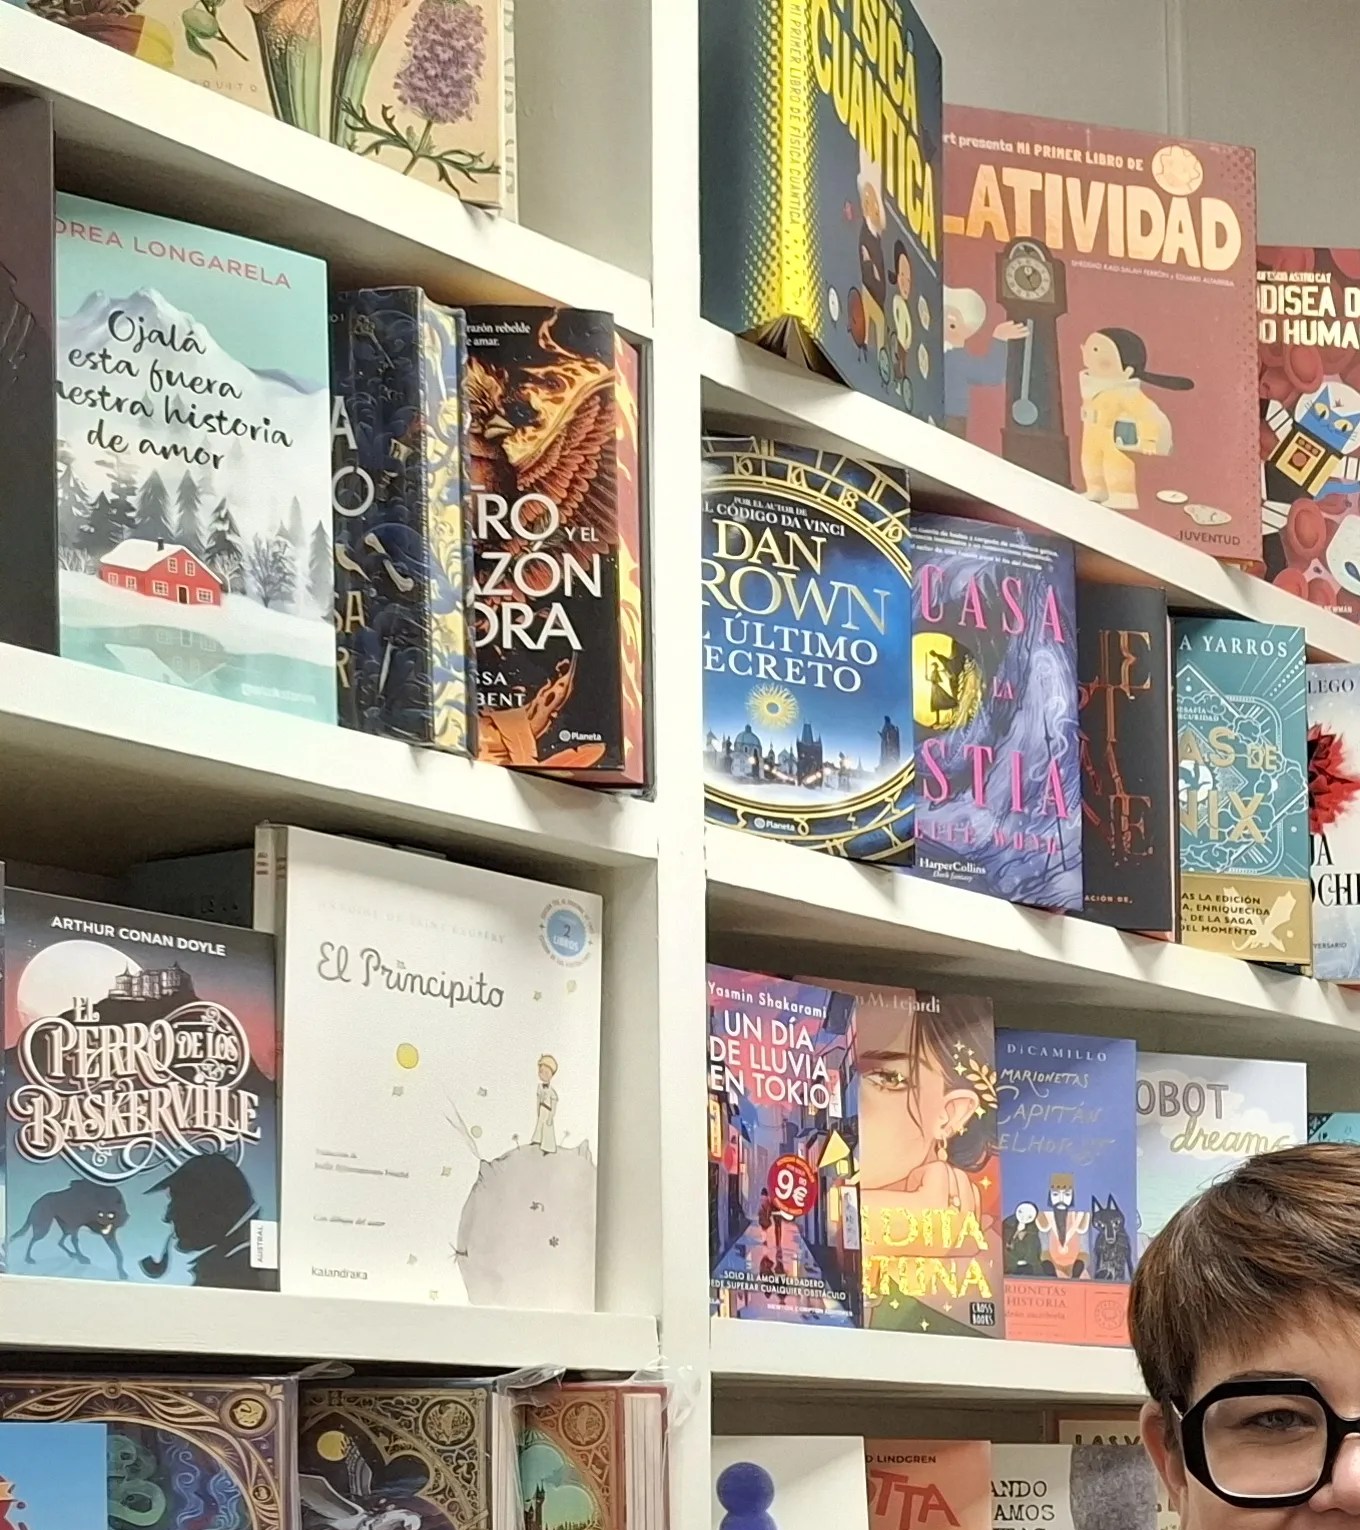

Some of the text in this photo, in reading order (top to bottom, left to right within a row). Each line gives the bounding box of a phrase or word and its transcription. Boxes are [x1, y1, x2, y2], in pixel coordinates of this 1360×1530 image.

[789, 19, 802, 103] PRIMER LIBRO
[812, 0, 937, 262] CUÁNTICA
[958, 135, 1144, 172] presenta MI PRIMER LIBRO DE
[56, 217, 292, 290] DREA LONGARELA
[1257, 284, 1337, 318] DISEA
[106, 309, 208, 356] Ojalá
[494, 321, 532, 335] rebelde
[67, 346, 244, 400] esta fuera
[164, 394, 294, 449] historia
[86, 418, 226, 471] de amor
[564, 526, 600, 543] Y EL
[716, 500, 846, 537] CÓDIGO DA VINCI
[1177, 527, 1242, 548] JUVENTUD
[712, 517, 828, 577] DAN
[701, 557, 892, 636] ROWN
[918, 563, 1066, 645] CASA
[721, 611, 879, 667] ÚLTIMO
[1200, 636, 1290, 659] YARROS
[703, 643, 863, 693] ECRETO
[991, 674, 1015, 701] LA
[1246, 742, 1280, 772] DE
[922, 737, 1070, 820] STIA
[918, 857, 988, 876] HarperCollins
[1196, 904, 1271, 917] ENRIQUECIDA
[1215, 893, 1261, 905] EDICIÓN
[51, 915, 227, 957] ARTHUR CONAN DOYLE
[1201, 925, 1258, 937] MOMENTO
[1224, 916, 1254, 926] SAGA
[551, 934, 580, 952] LIBROS
[316, 940, 506, 1008] El Principito
[73, 996, 100, 1022] EL
[708, 980, 827, 1019] Yasmin Shakarami
[46, 1016, 175, 1082] PERRO
[724, 1009, 815, 1053] UN DÍA
[709, 1035, 831, 1083] DE LLUVIA
[710, 1063, 831, 1110] EN TOKIO
[1000, 1067, 1091, 1099] MARIONETAS
[1135, 1078, 1230, 1120] OBOT
[255, 1224, 265, 1265] AUSTRAL
[311, 1264, 369, 1281] kalandraka
[724, 1279, 847, 1302] SUPERAR CUALQUIER OBSTÁCULO
[757, 1272, 825, 1289] AMOR VERDADERO
[876, 1454, 937, 1464] LINDGREN
